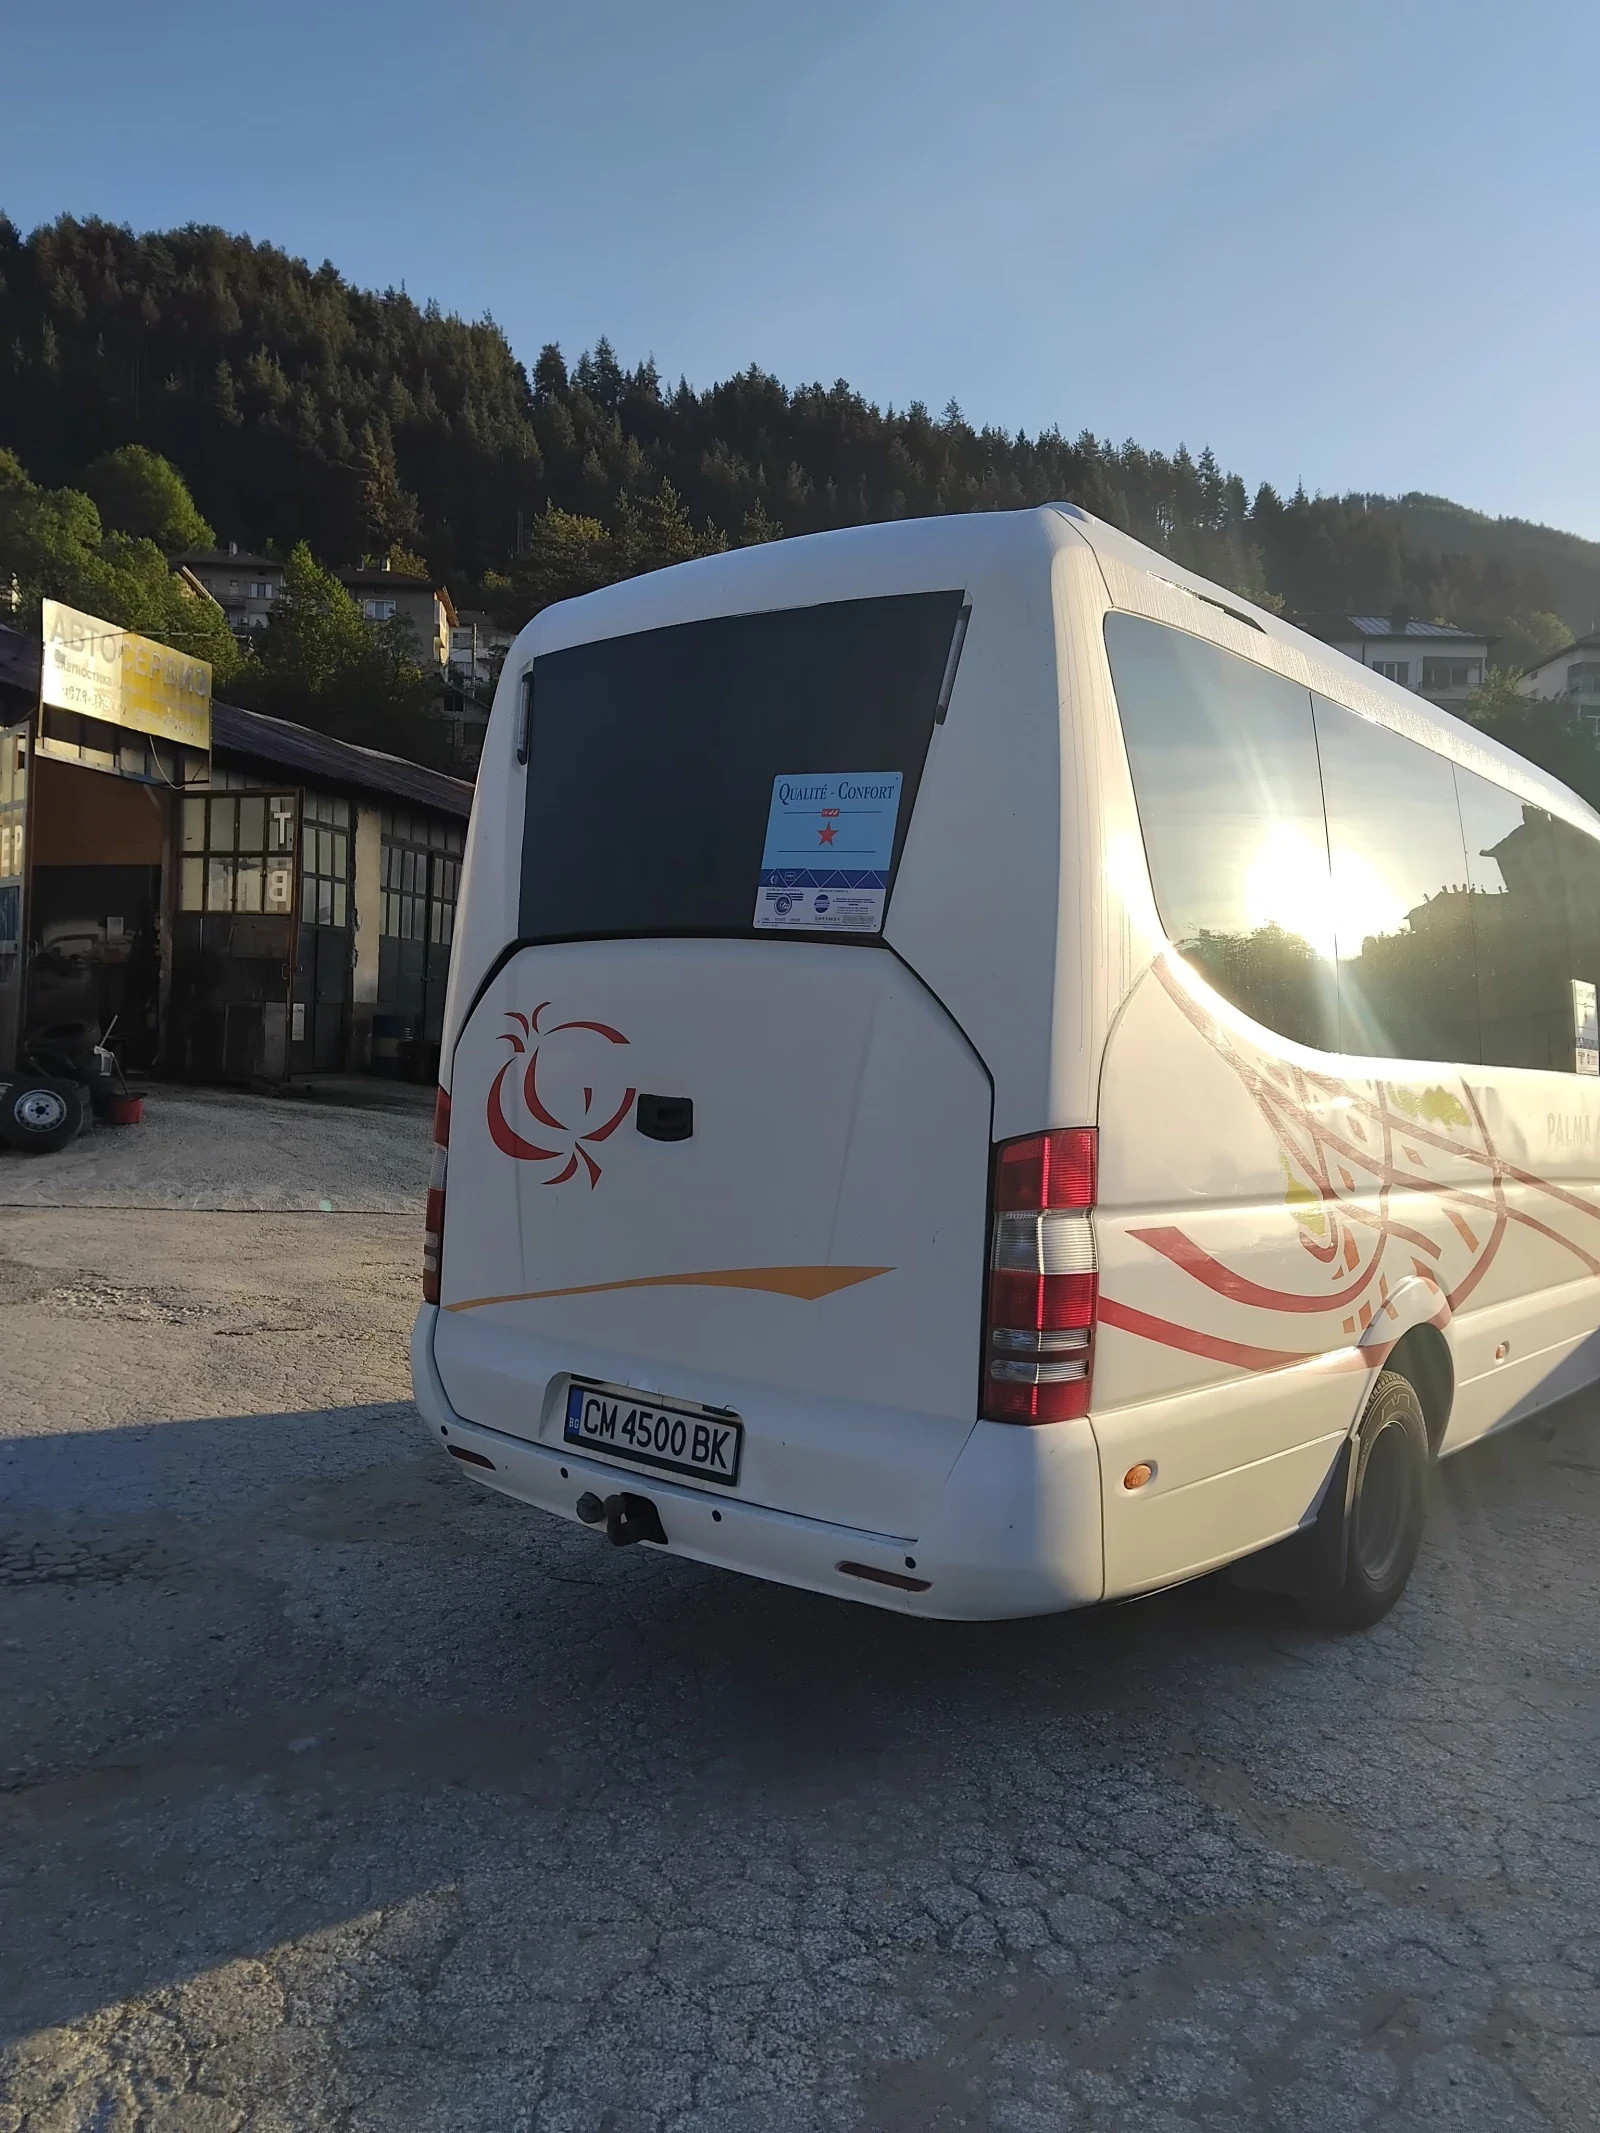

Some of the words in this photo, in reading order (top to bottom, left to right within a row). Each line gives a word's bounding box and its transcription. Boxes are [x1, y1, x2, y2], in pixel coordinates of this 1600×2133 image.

[779, 783, 828, 805] QUALITÉ
[838, 781, 895, 801] CONFORT
[1546, 1112, 1592, 1146] PALMA
[568, 1416, 580, 1430] BG
[583, 1398, 618, 1440] CM
[621, 1409, 687, 1457] 4500
[691, 1424, 731, 1470] BK
